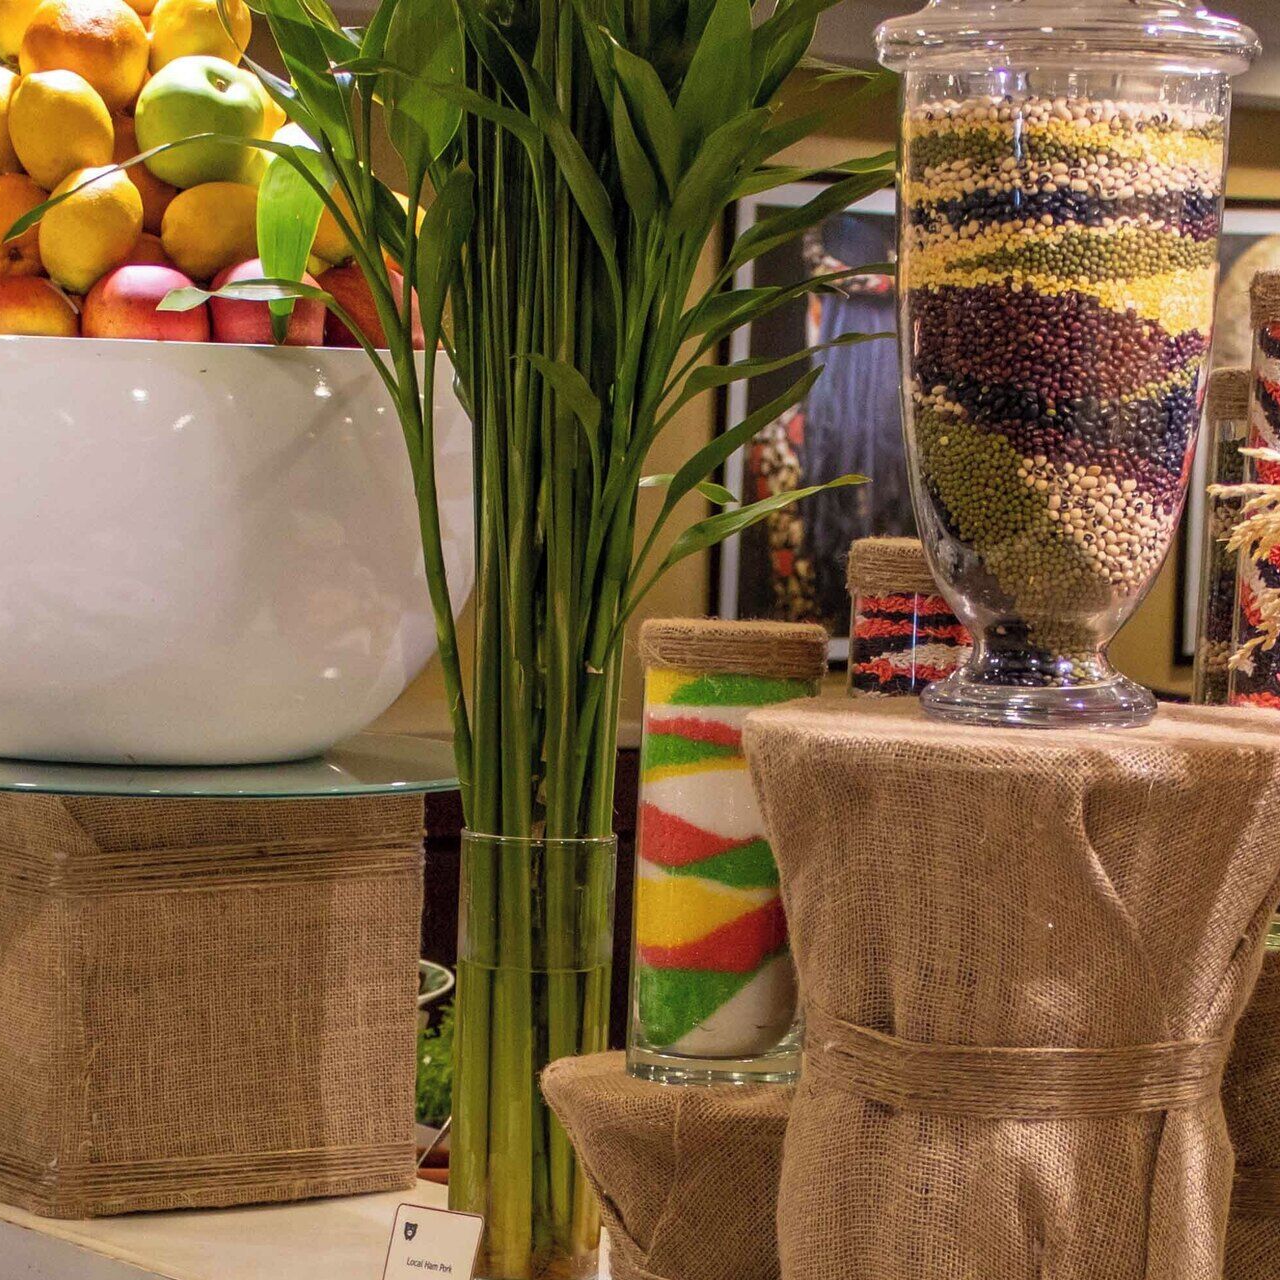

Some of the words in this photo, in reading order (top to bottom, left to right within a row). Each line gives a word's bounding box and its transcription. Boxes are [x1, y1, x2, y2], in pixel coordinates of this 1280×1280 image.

[406, 1257, 423, 1269] Local
[424, 1260, 439, 1271] Ham
[439, 1263, 452, 1275] Pork
